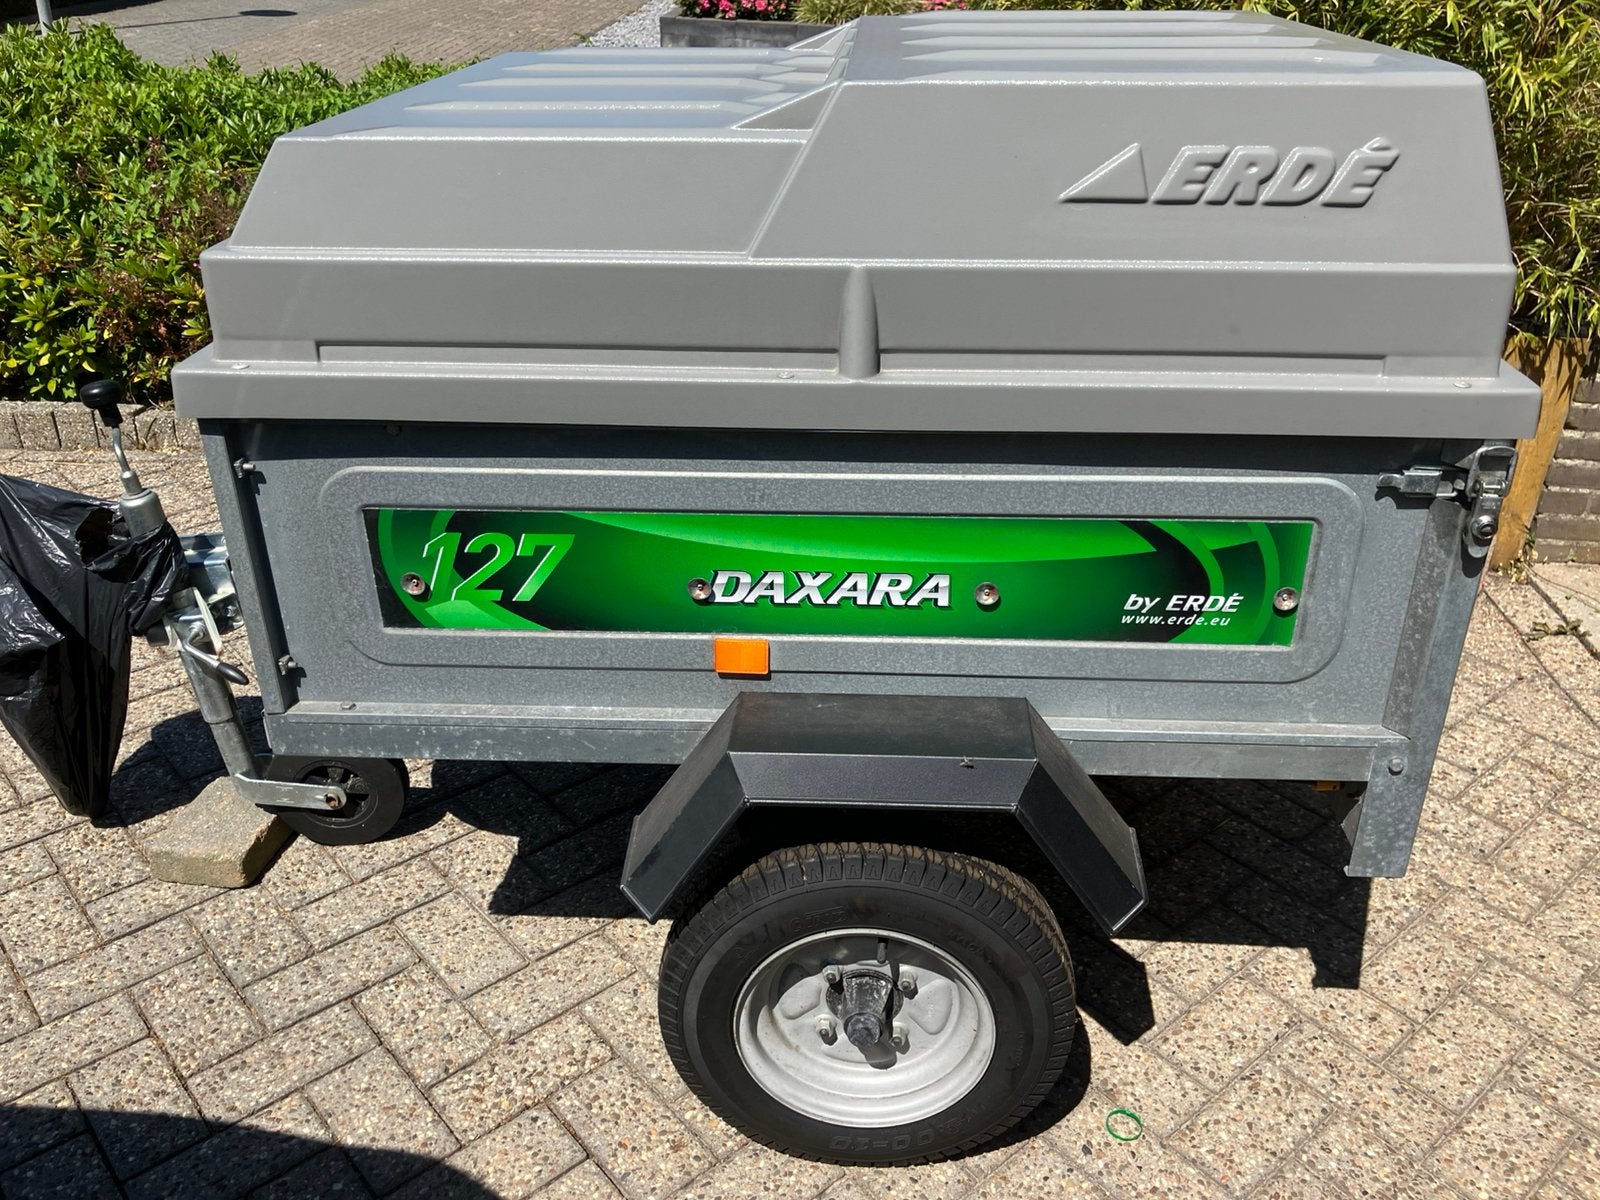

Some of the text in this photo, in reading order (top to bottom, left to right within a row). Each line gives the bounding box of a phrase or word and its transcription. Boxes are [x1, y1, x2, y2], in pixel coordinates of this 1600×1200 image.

[1150, 136, 1401, 208] ERDÉ
[422, 532, 576, 602] 127
[711, 569, 952, 607] DAXARA
[1122, 593, 1244, 614] by ERDÉ
[1120, 613, 1231, 627] www.erde.eu
